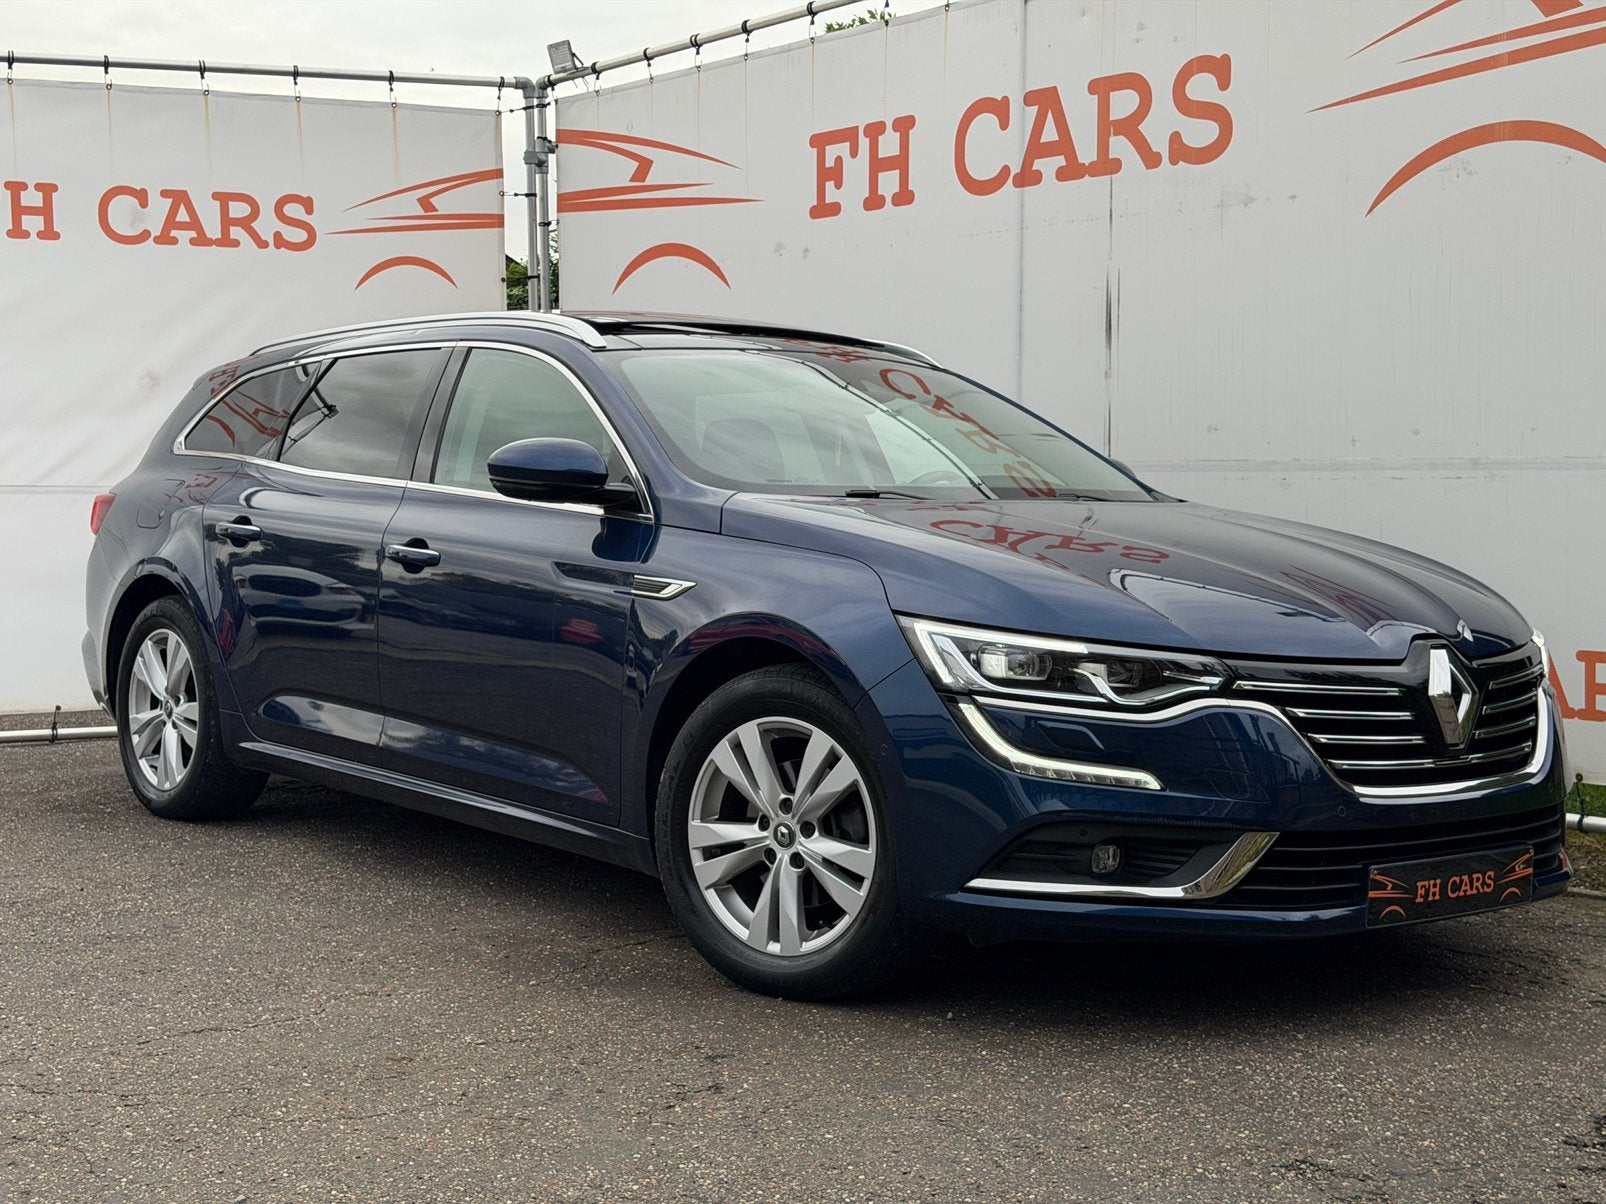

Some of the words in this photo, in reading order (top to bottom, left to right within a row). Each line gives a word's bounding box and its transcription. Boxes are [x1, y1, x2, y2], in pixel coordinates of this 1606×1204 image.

[809, 115, 916, 220] FH
[954, 54, 1234, 197] CARS
[98, 185, 317, 253] CARS
[1415, 878, 1442, 903] FH
[1447, 870, 1495, 899] CARS
